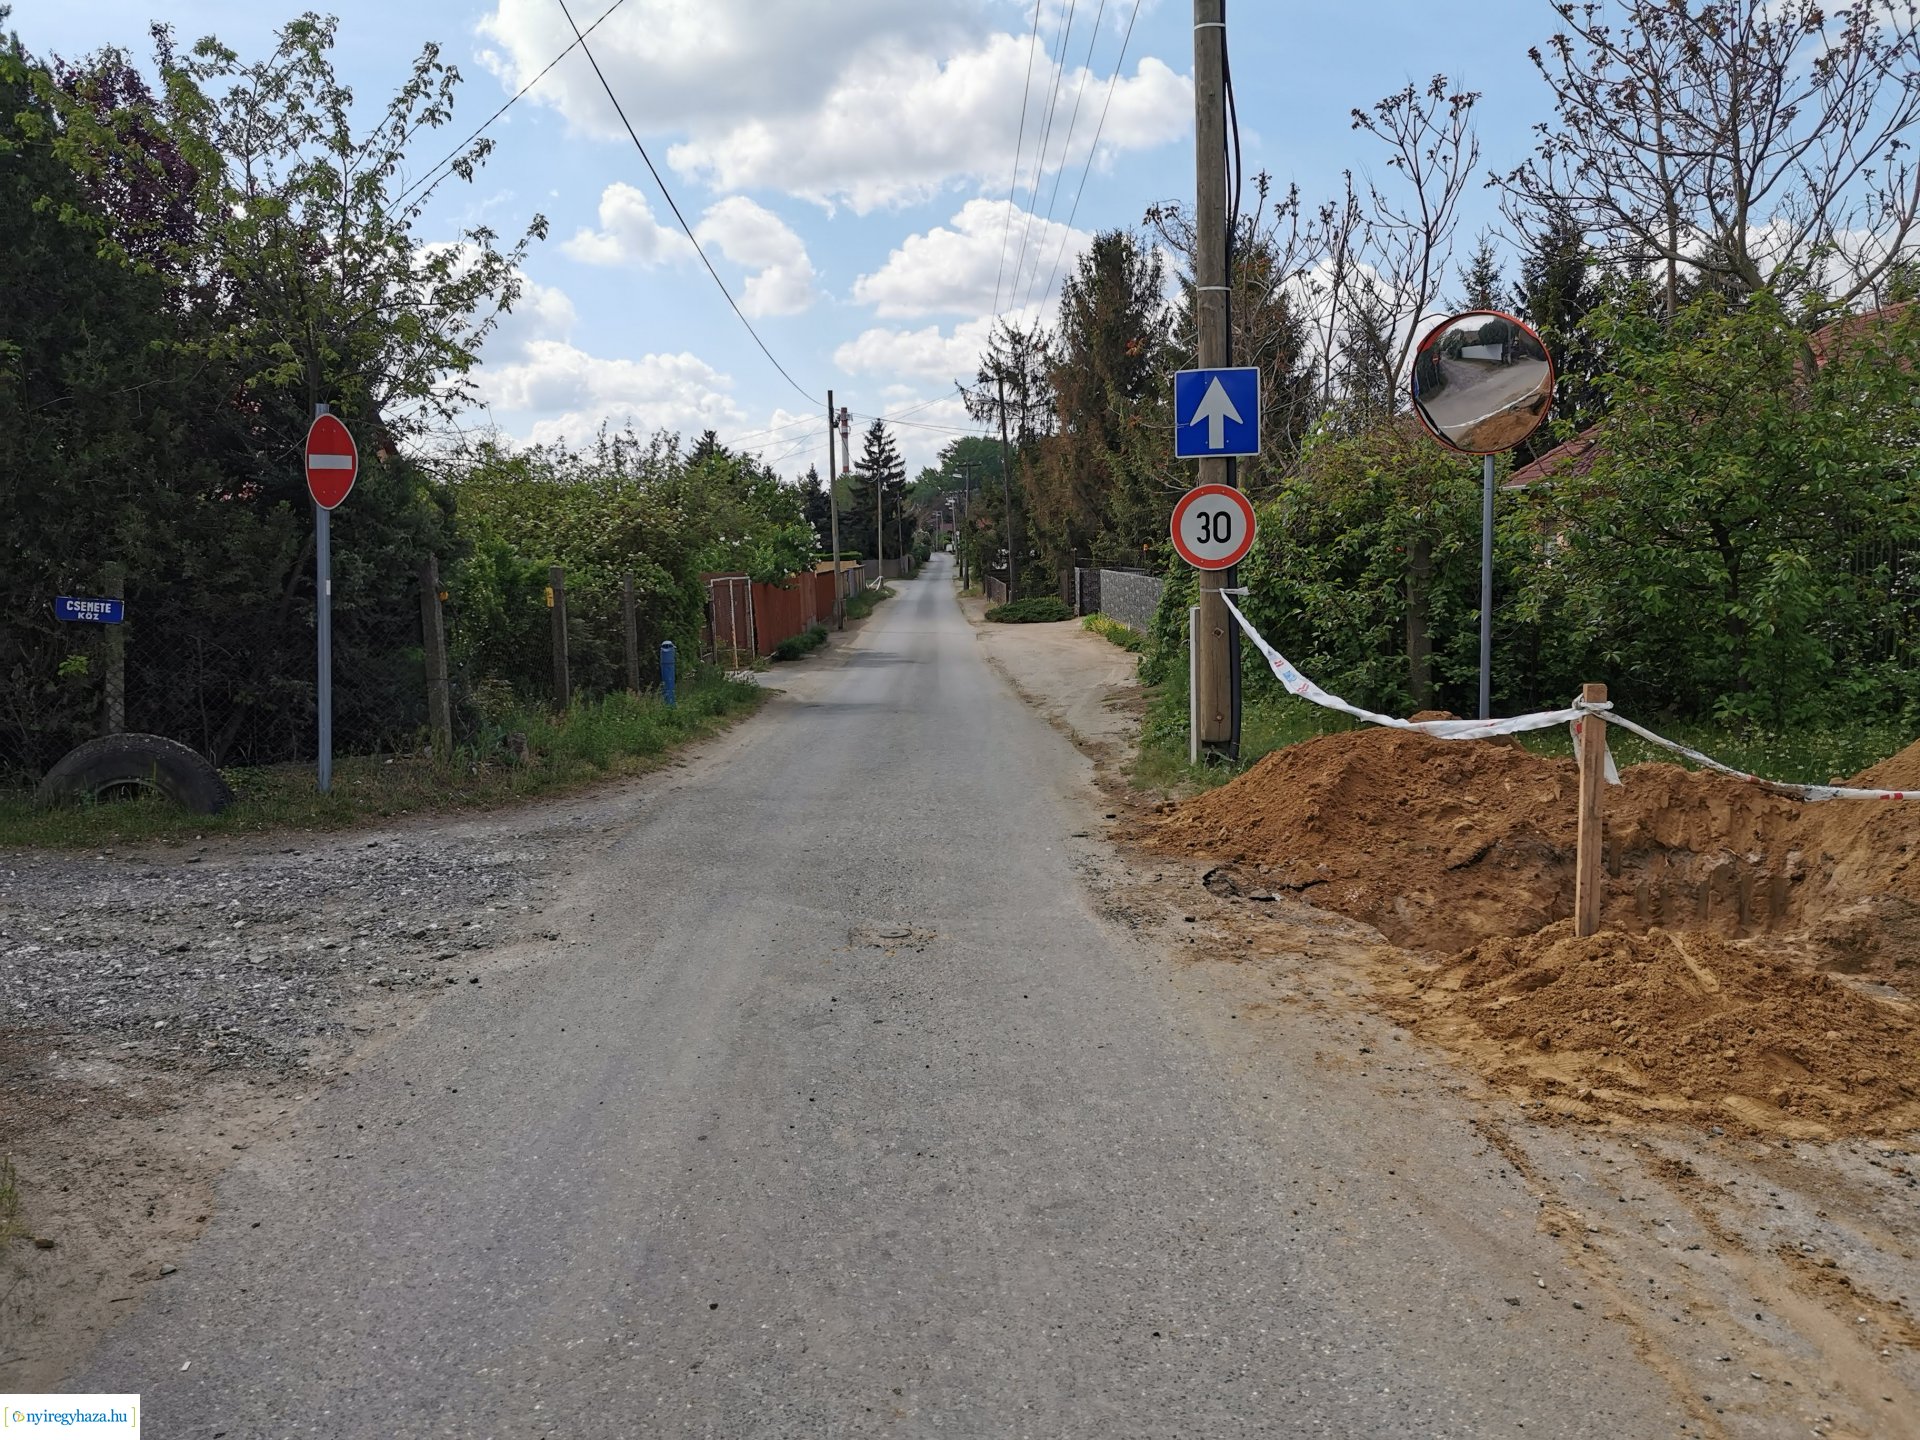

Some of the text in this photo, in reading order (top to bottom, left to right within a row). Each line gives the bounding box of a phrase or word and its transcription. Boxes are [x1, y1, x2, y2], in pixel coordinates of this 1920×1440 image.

[1196, 511, 1232, 543] 30
[66, 600, 112, 613] CSEMETE
[77, 611, 100, 620] KÖZ
